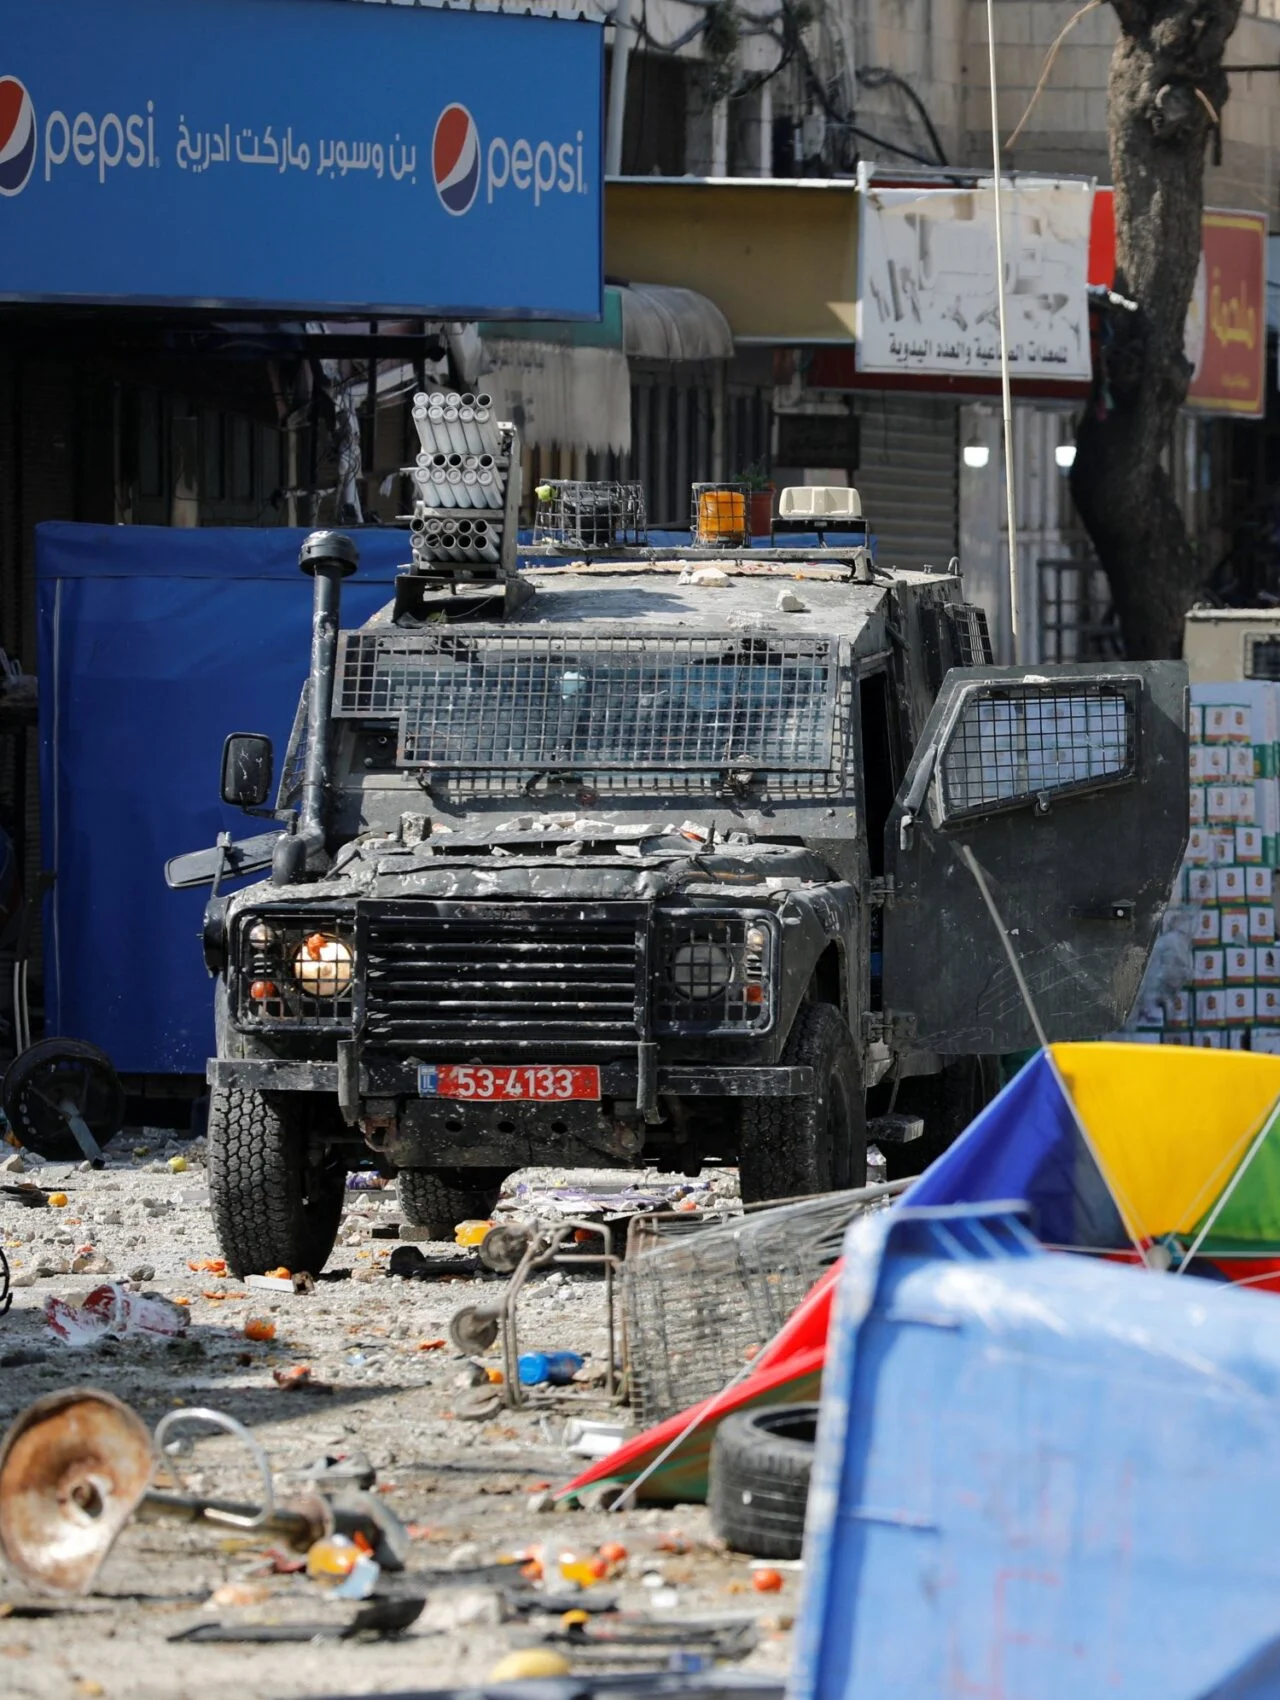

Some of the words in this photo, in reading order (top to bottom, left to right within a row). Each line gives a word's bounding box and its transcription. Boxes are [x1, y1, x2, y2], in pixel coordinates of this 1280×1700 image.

[45, 100, 155, 183] pepsi
[235, 125, 310, 174] ماركت
[316, 138, 385, 180] وسوبر
[388, 132, 417, 185] بن
[487, 130, 584, 206] pepsi
[974, 336, 1023, 367] الصاعية
[456, 1067, 573, 1098] 53-4133
